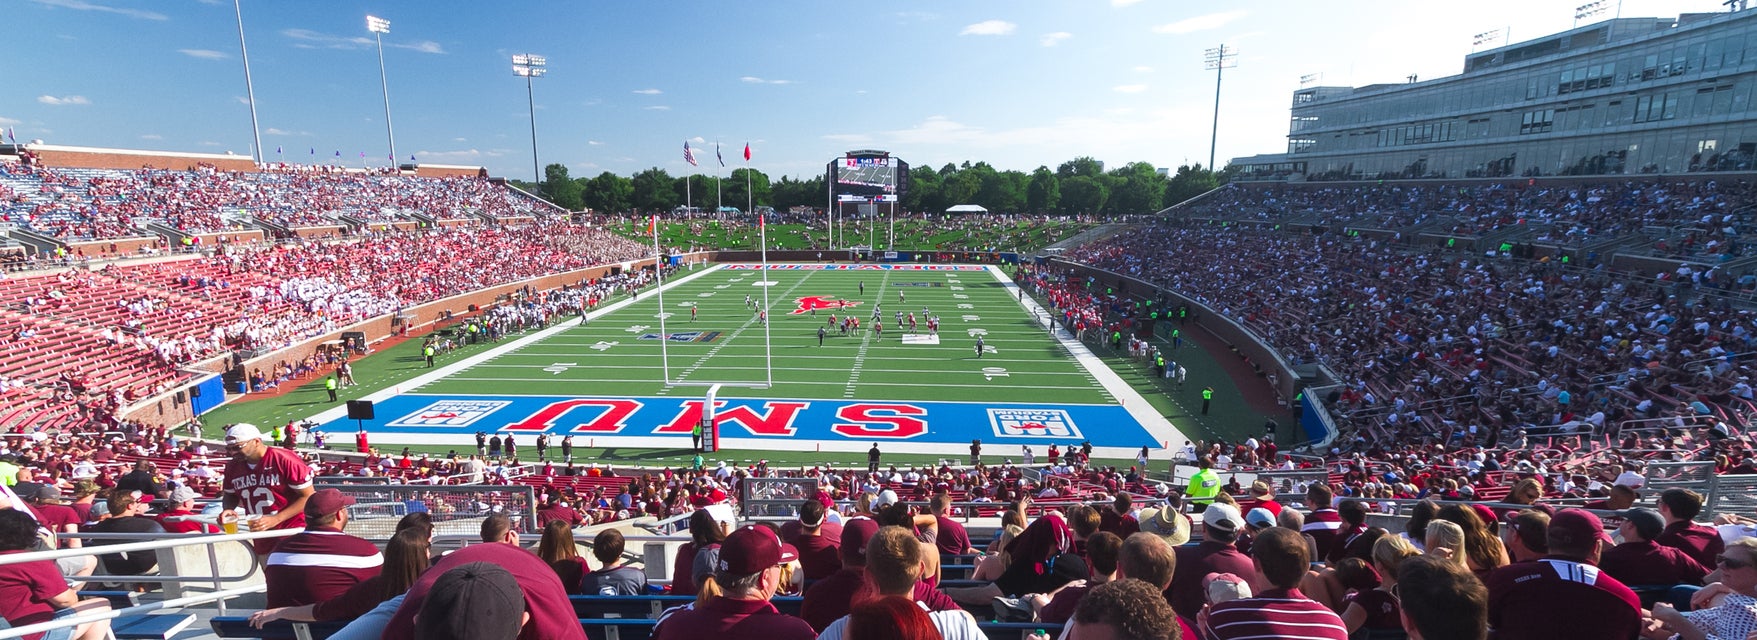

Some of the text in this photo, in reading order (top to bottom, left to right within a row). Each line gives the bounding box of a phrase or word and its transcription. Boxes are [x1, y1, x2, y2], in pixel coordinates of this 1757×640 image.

[498, 398, 929, 439] SMU
[231, 473, 280, 489] TEXAS A&M
[241, 487, 278, 516] 12
